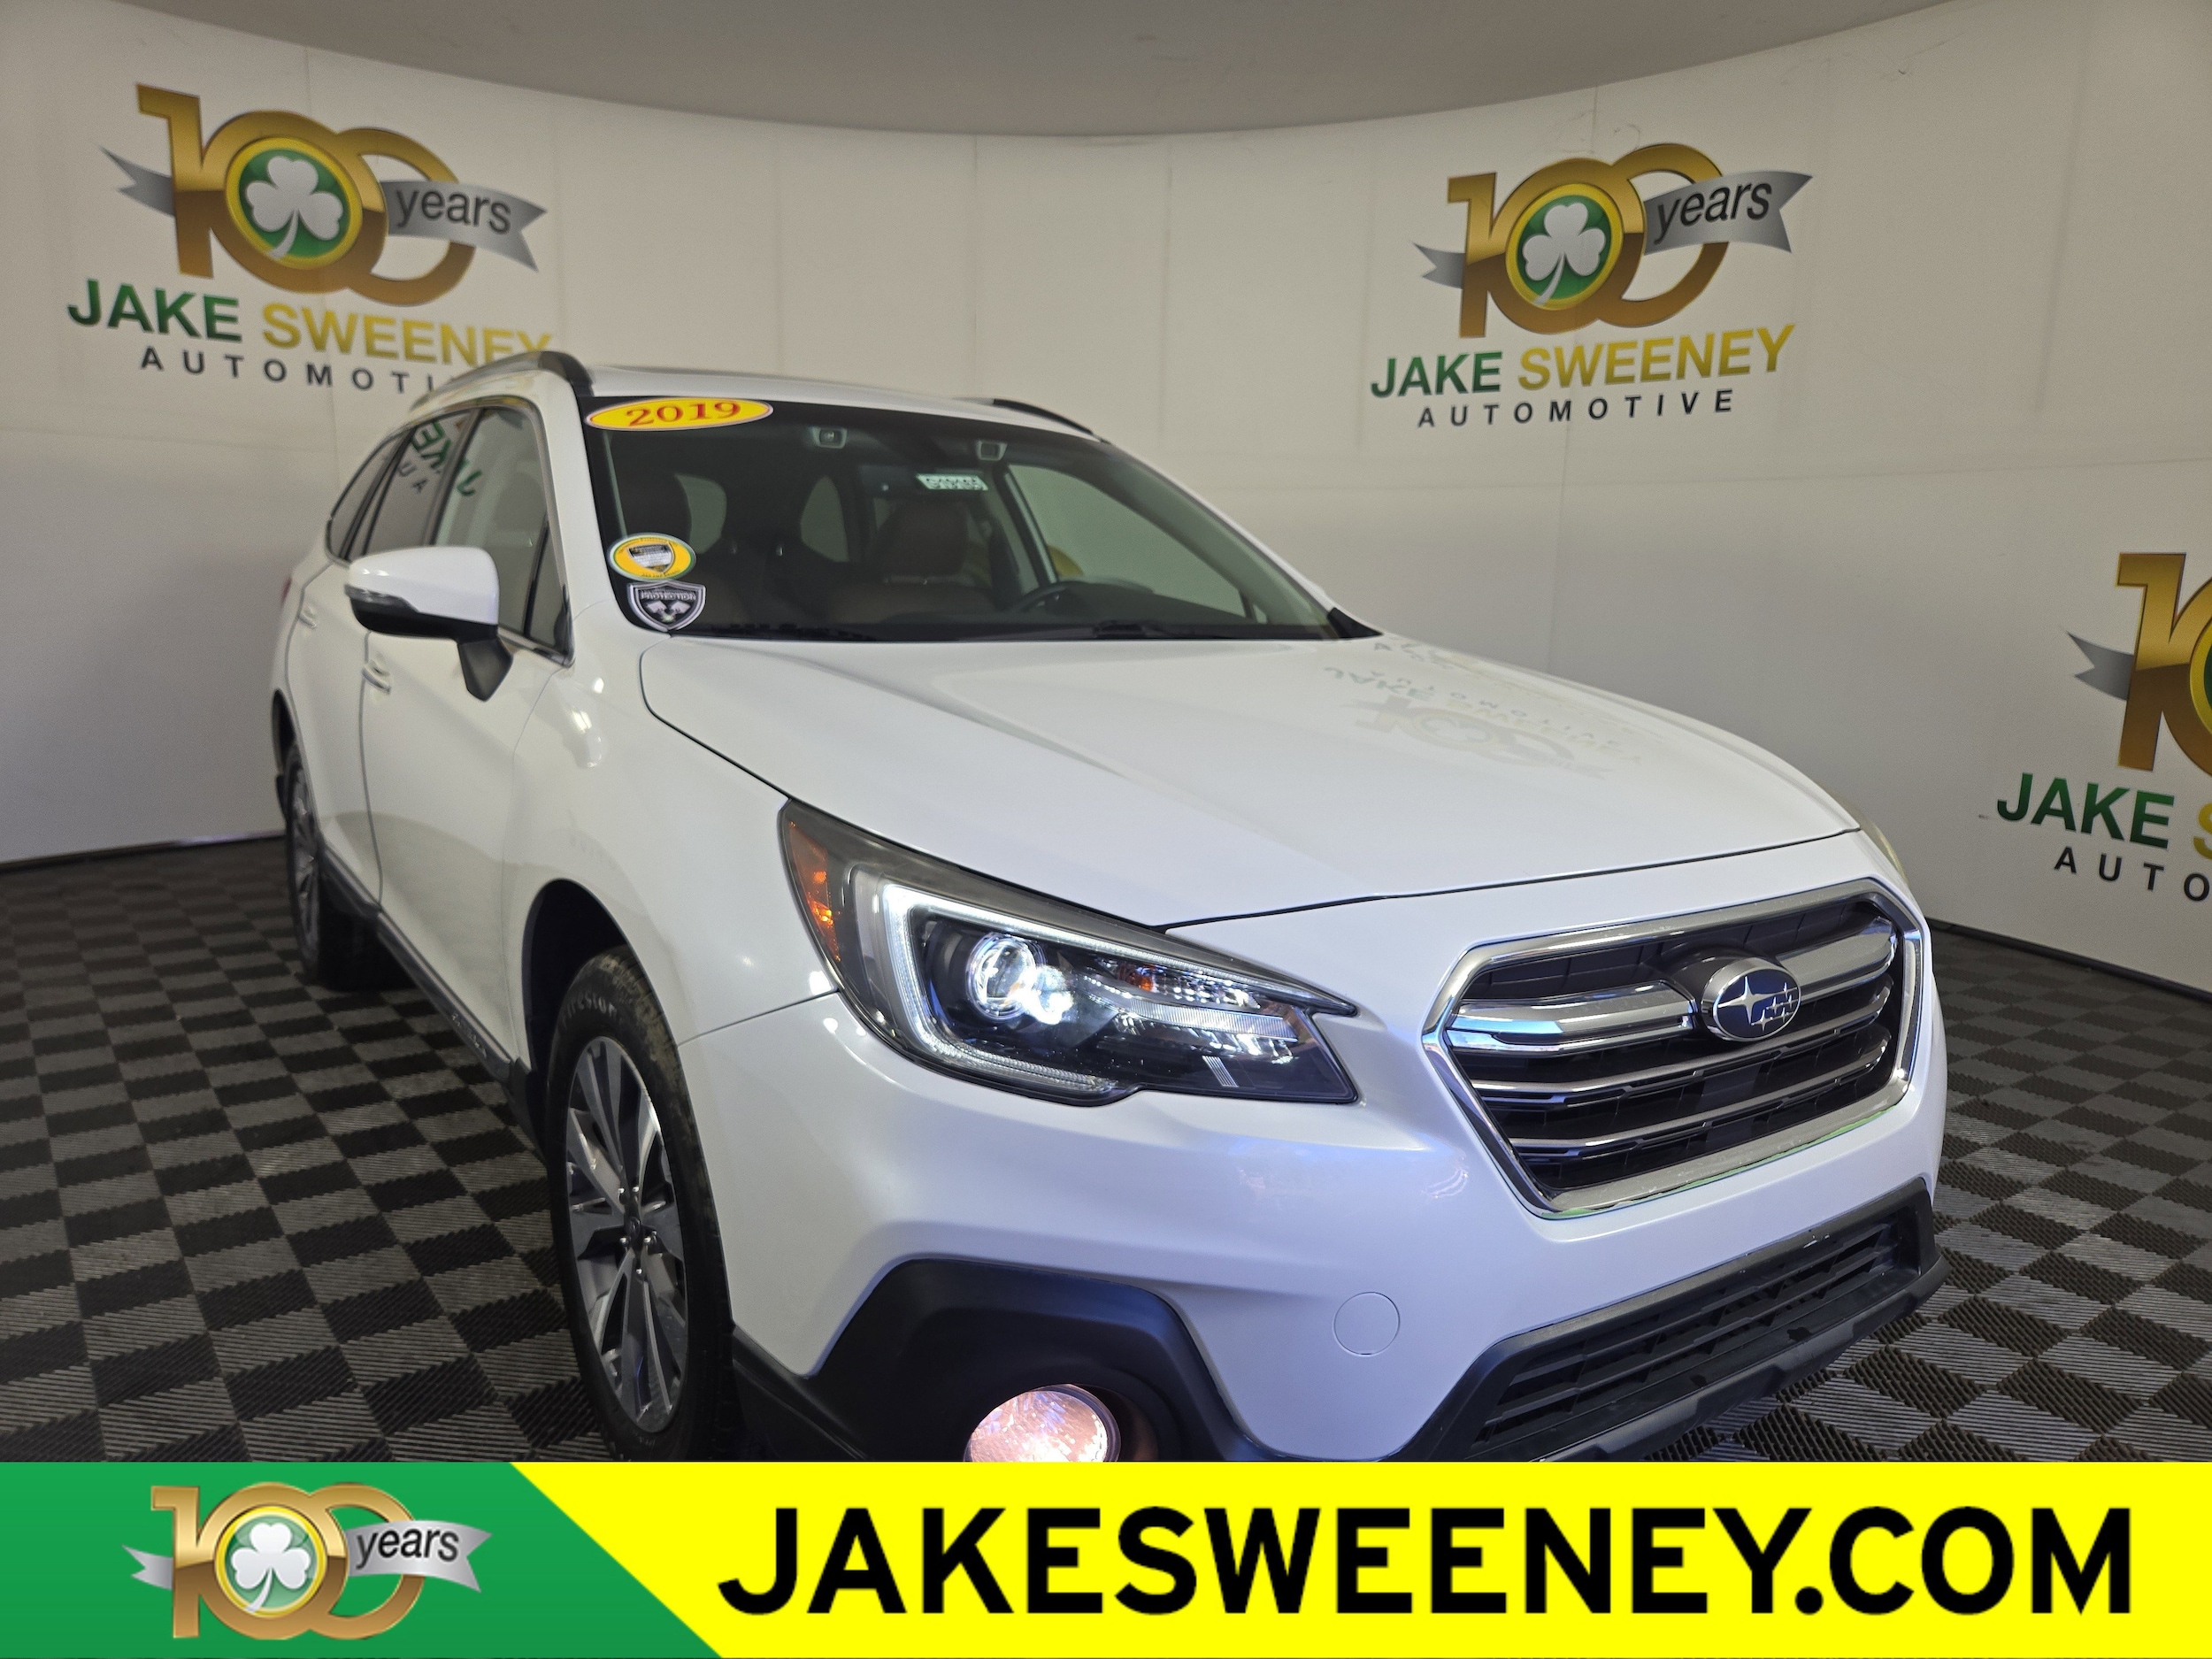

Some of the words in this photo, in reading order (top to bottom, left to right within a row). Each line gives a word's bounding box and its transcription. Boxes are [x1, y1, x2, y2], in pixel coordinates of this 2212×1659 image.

[135, 83, 476, 307] 100
[396, 187, 512, 235] years
[1447, 143, 1731, 339] 100
[1654, 182, 1773, 245] years
[68, 278, 242, 342] JAKE
[141, 346, 434, 393] AUTOMOTI
[1371, 350, 1503, 399] JAKE
[1517, 323, 1796, 391] SWEENEY
[626, 401, 741, 426] 2019
[1417, 389, 1732, 428] AUTOMOTIVE
[1997, 772, 2175, 849] JAKE
